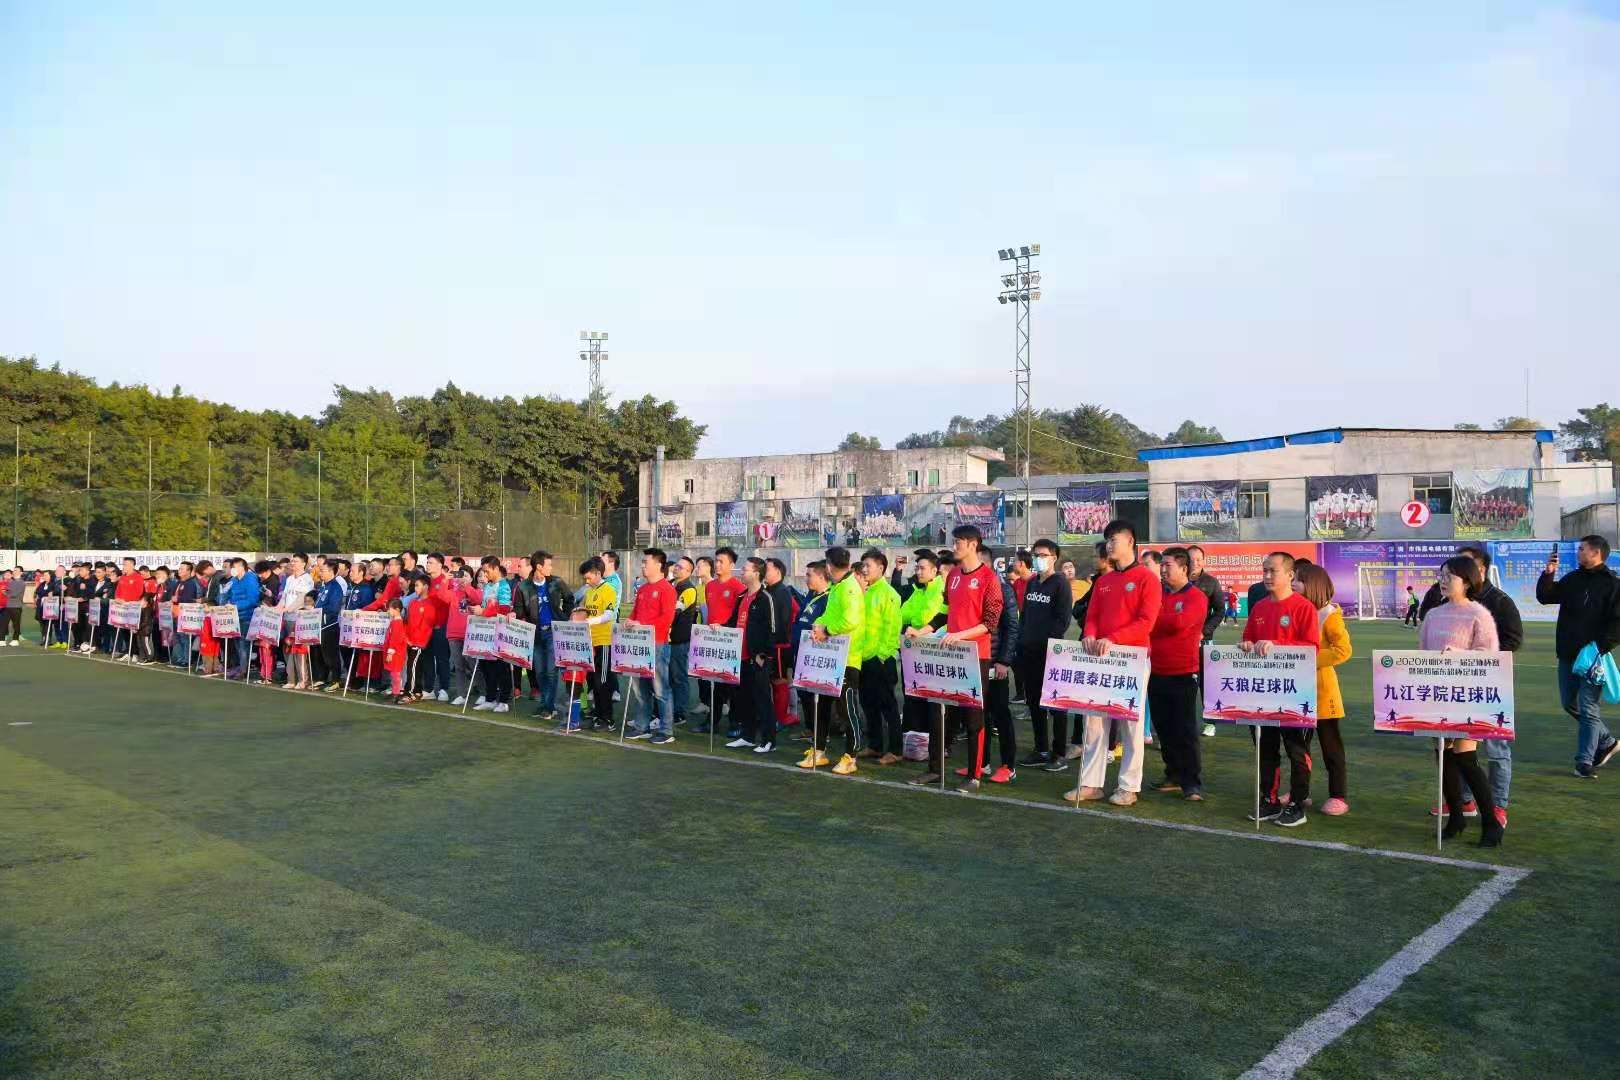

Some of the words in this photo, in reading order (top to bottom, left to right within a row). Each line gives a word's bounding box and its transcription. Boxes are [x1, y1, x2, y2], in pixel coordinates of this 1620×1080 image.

[1407, 503, 1422, 524] 2
[1026, 592, 1051, 604] adidas
[913, 661, 969, 680] 长圳足球队
[1047, 667, 1139, 691] 光明震泰足球队
[1220, 677, 1298, 694] 天狼足球队
[1383, 683, 1502, 703] 九江学院足球队
